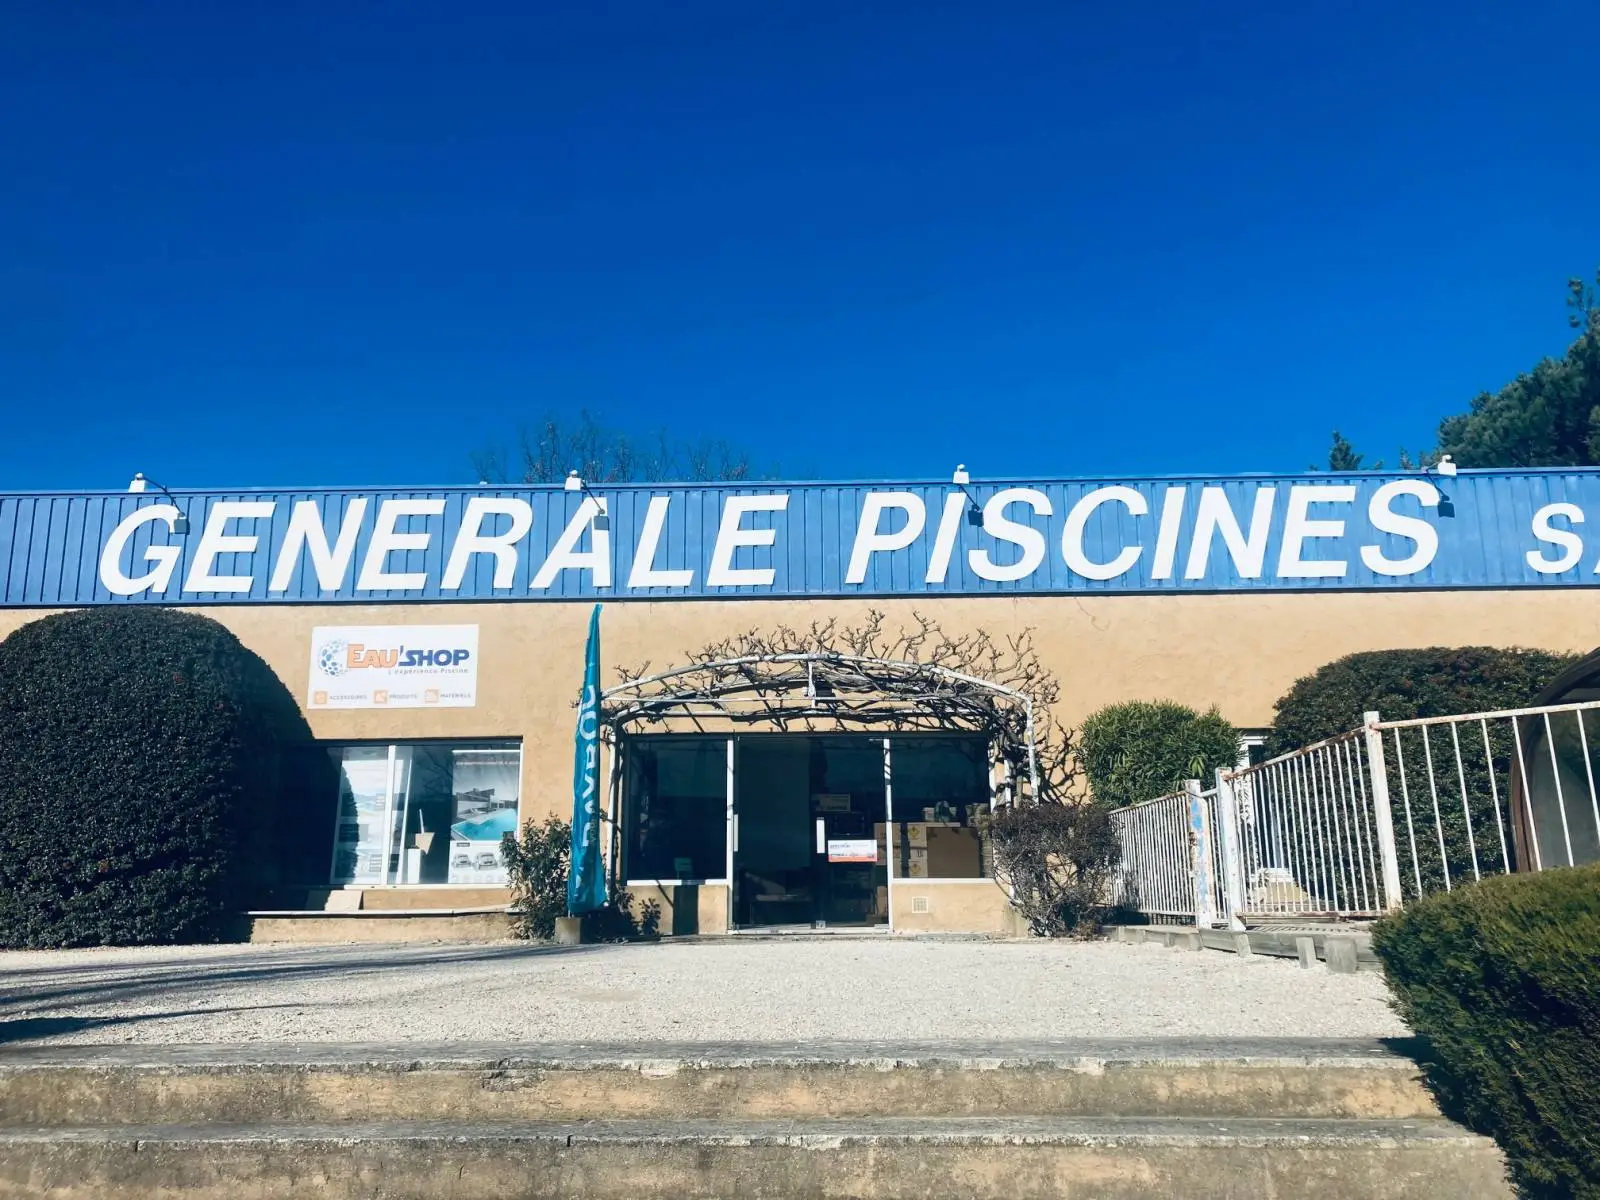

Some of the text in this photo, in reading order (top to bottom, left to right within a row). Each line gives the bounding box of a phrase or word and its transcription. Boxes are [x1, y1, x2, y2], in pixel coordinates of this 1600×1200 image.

[100, 479, 1600, 596] GENERALE PISCINES S
